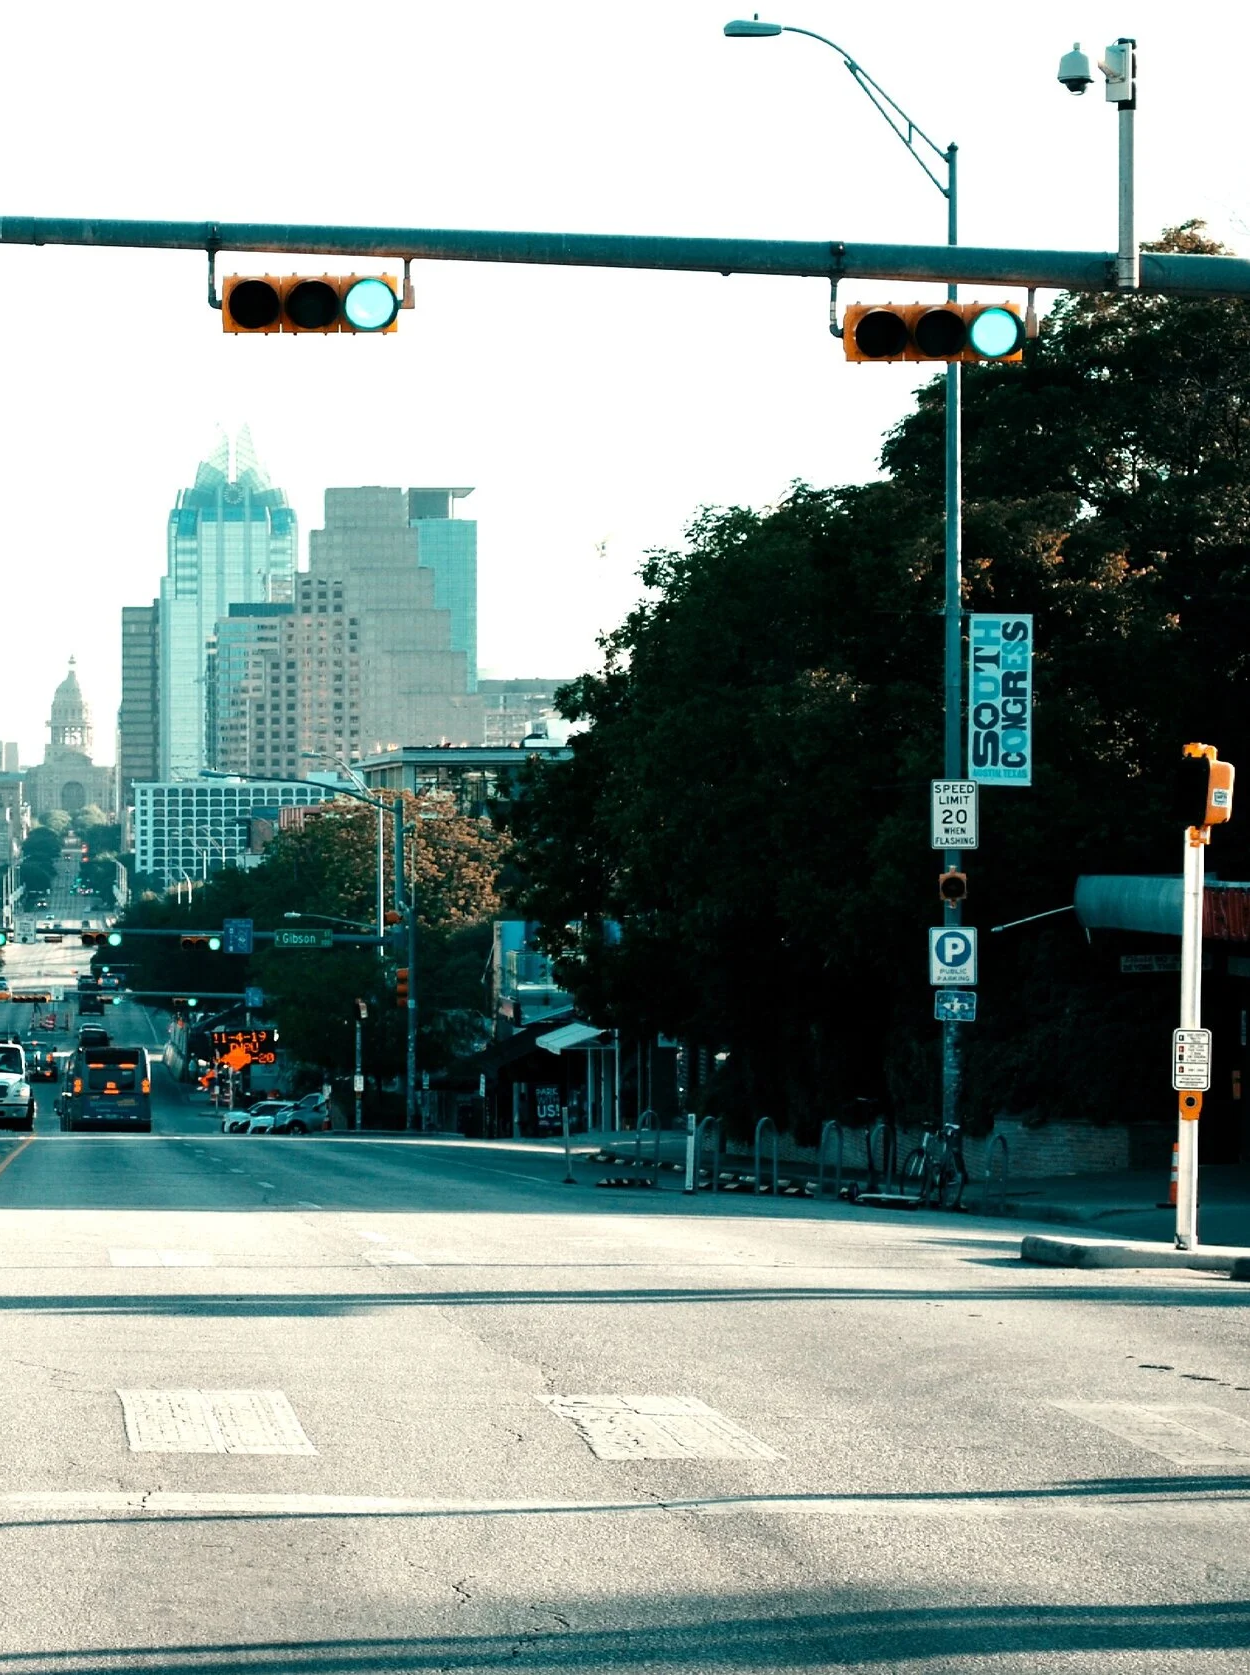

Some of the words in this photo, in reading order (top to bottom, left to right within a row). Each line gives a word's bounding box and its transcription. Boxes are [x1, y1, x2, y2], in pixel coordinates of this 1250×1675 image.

[972, 620, 1000, 768] SOUTH
[1001, 620, 1029, 768] CONGRESS
[1003, 769, 1028, 779] TEXAS
[934, 784, 974, 793] SPEED
[939, 795, 970, 805] LIMIT
[941, 809, 967, 824] 20
[944, 827, 966, 835] WHEN
[934, 837, 974, 845] FLASHING
[282, 933, 316, 944] Gibson
[537, 1104, 560, 1118] US!
